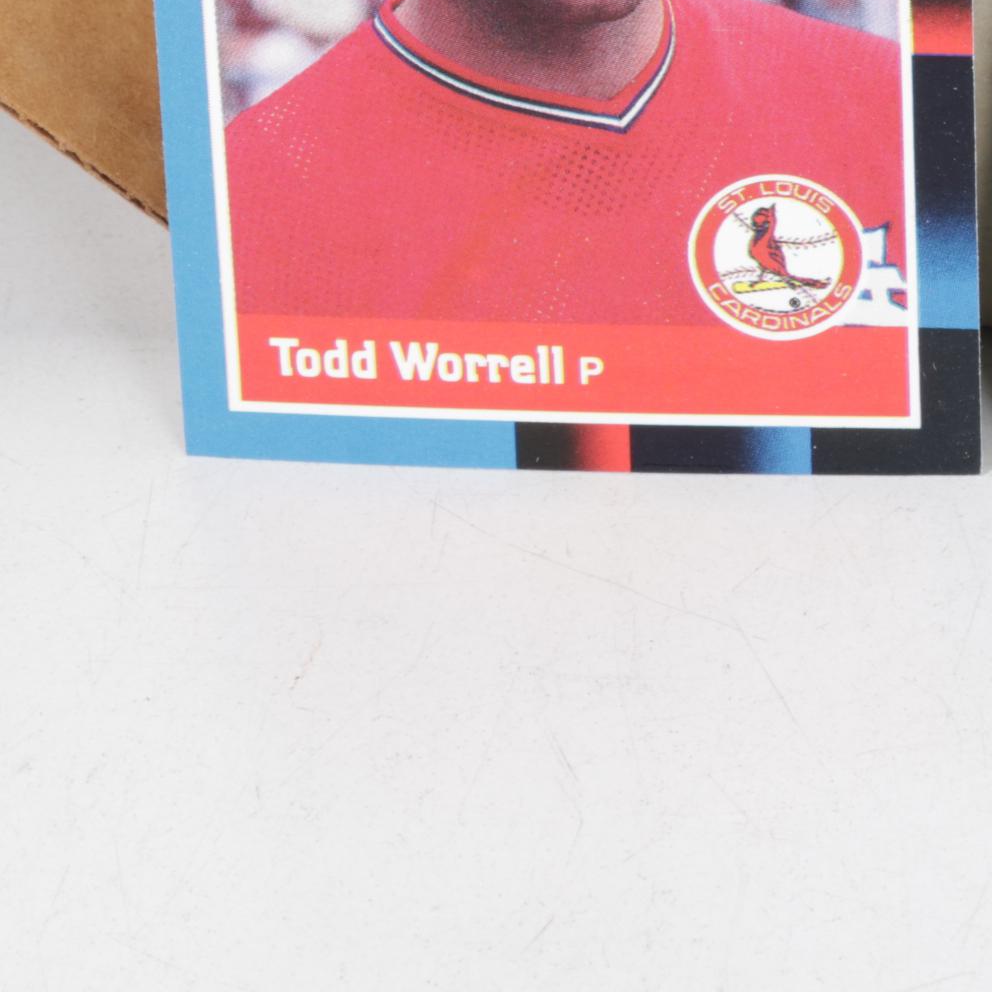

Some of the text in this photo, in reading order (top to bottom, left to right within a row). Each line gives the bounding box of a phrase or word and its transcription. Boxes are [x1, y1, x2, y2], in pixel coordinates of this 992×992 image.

[759, 181, 836, 215] LOUIS
[707, 281, 853, 331] CARDINALS
[268, 336, 605, 386] Todd Worrell P
